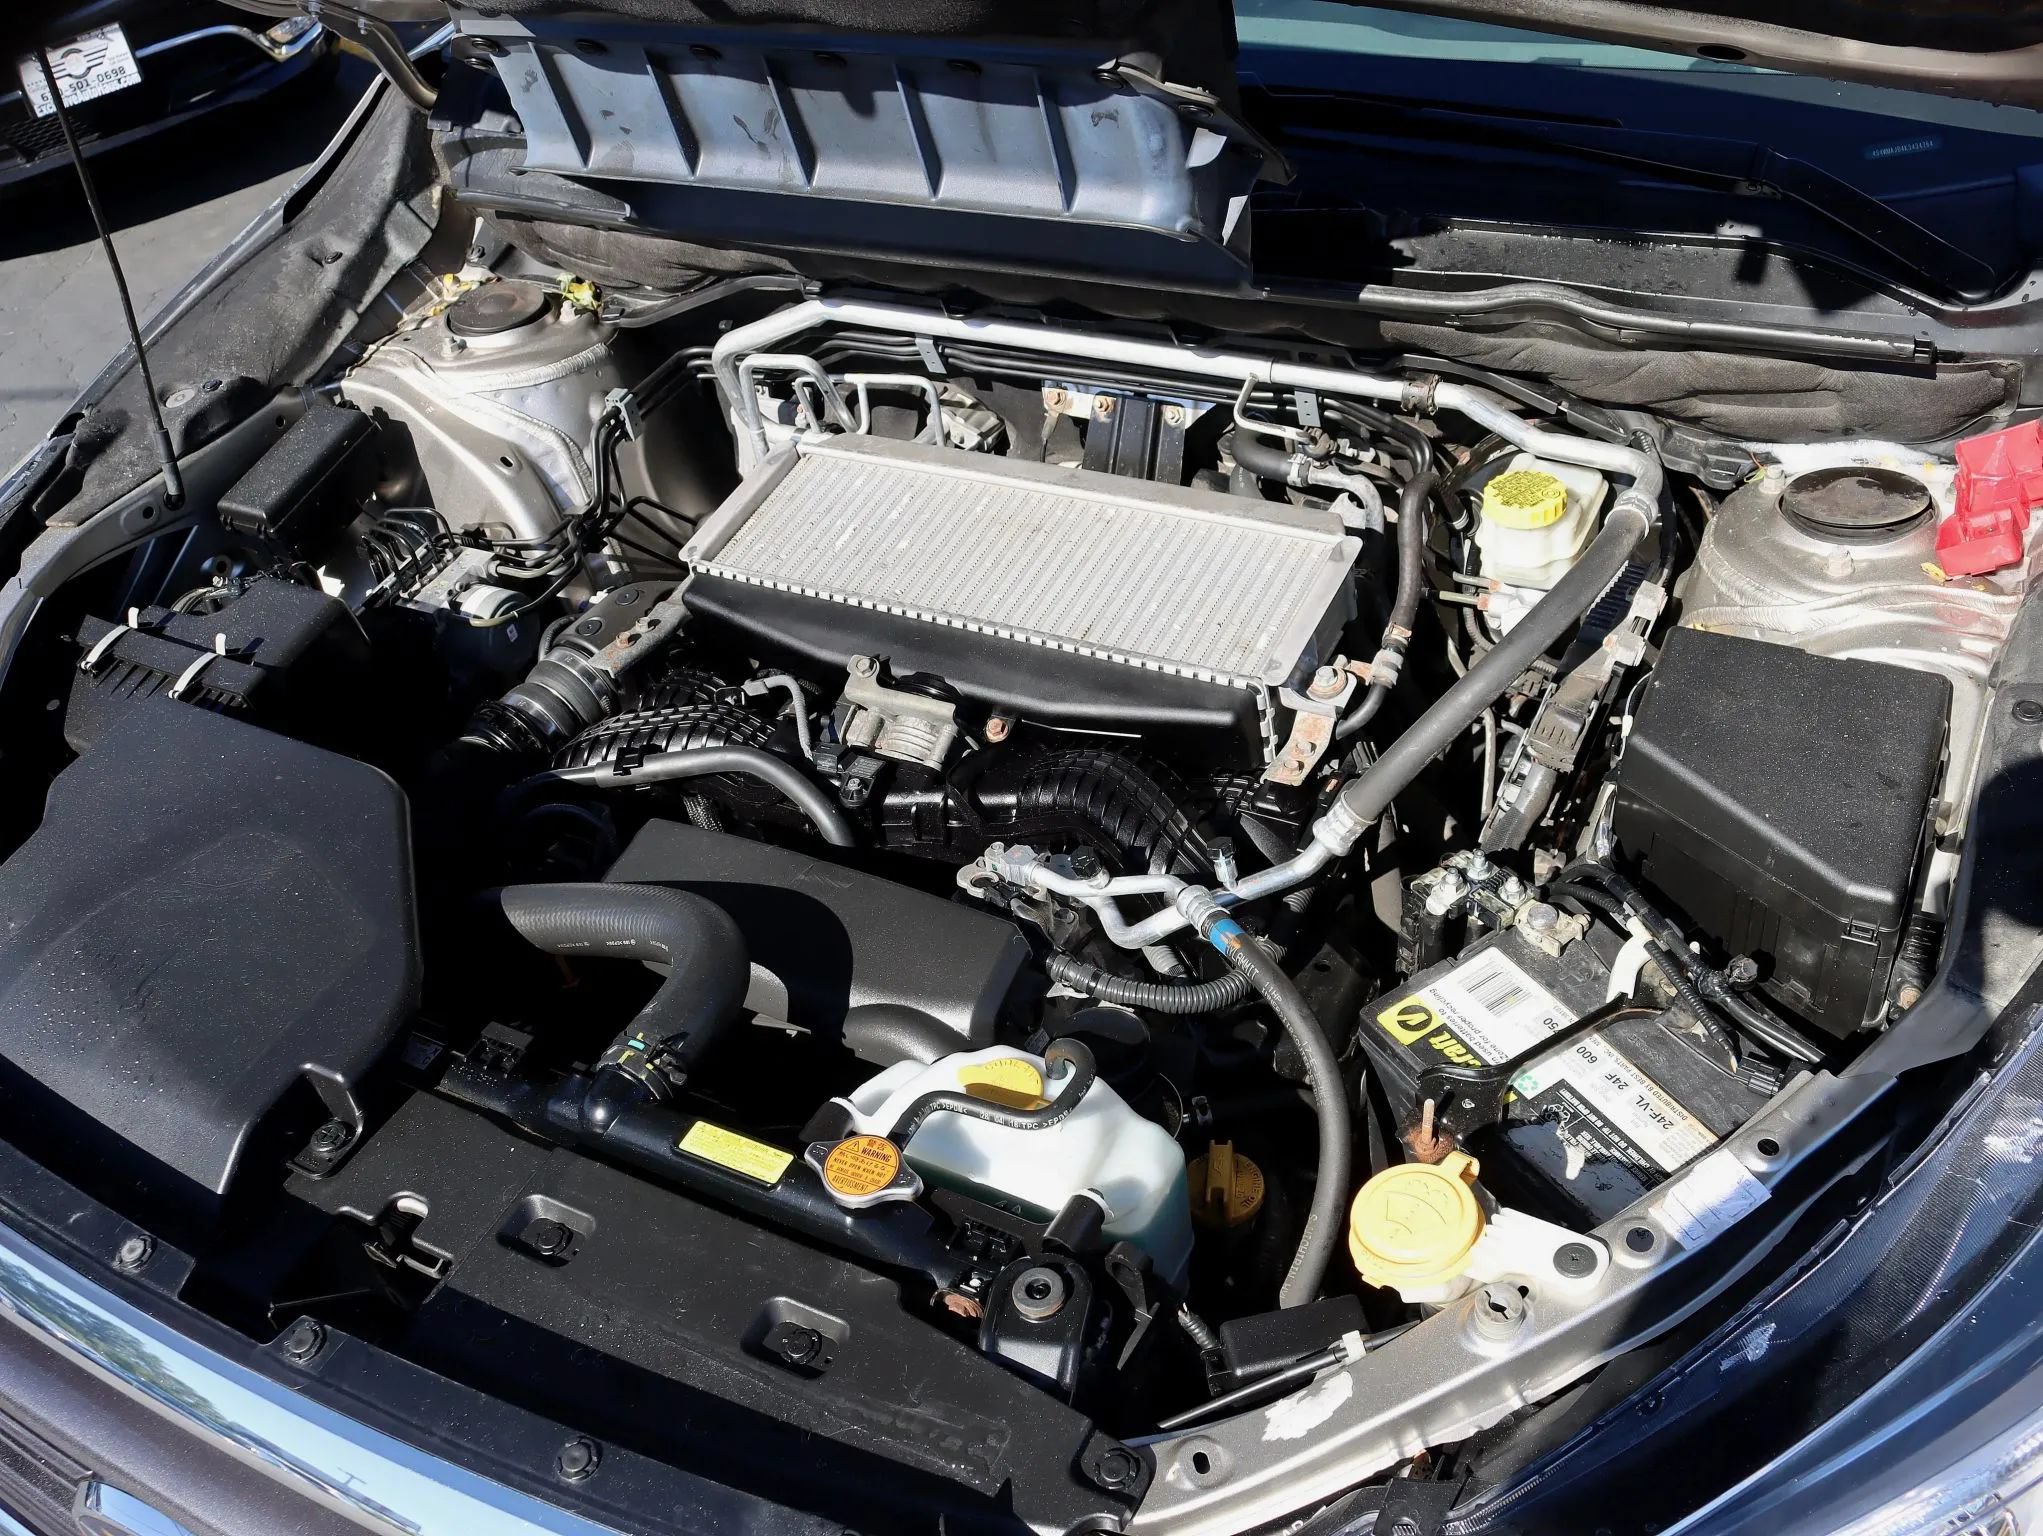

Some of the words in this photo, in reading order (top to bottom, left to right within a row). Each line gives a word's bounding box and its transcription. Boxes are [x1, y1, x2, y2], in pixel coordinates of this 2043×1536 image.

[1576, 1045, 1599, 1065] 600
[1604, 1072, 1630, 1091] 24F
[1635, 1094, 1675, 1130] 24F-VL
[861, 1147, 892, 1162] WARNING
